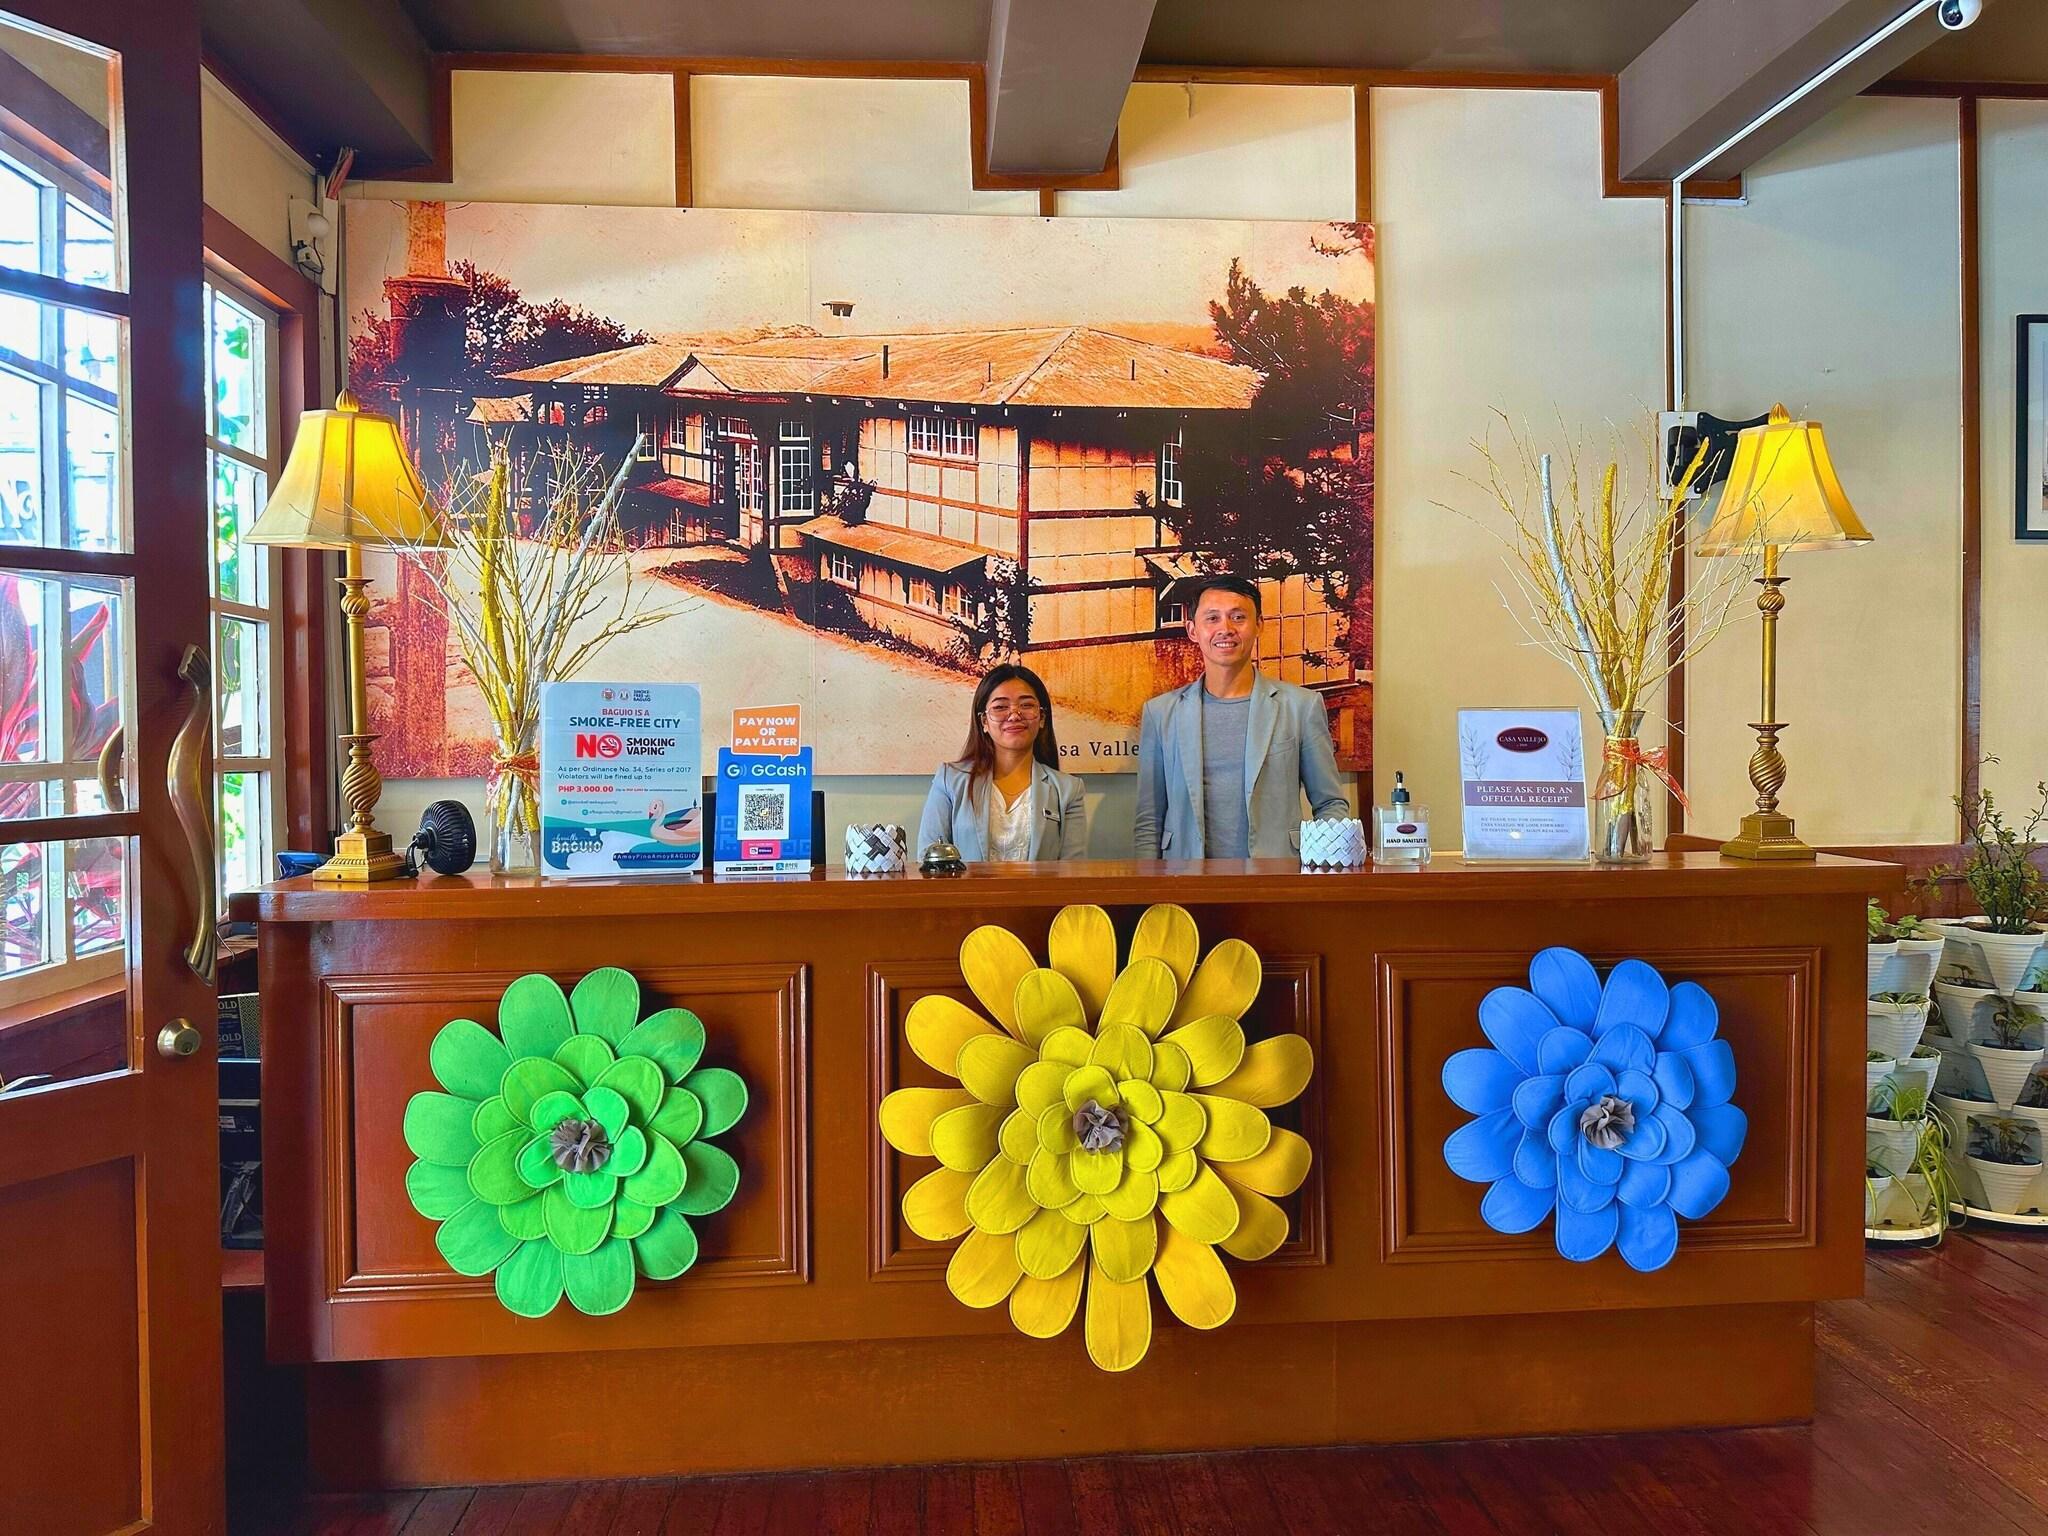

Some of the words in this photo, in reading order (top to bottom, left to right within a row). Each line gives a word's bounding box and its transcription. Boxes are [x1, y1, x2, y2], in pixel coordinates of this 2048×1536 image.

[602, 708, 633, 716] BAGUIO
[569, 717, 651, 728] SMOKE-FREE
[653, 718, 681, 728] CITY
[739, 717, 763, 726] PAY
[766, 717, 796, 726] NOW
[759, 727, 777, 736] OR
[626, 737, 675, 747] SMOKING
[735, 737, 760, 746] PAY
[761, 737, 798, 746] LATER
[1517, 736, 1546, 744] VALLEJO
[626, 747, 665, 756] VAPING
[1059, 744, 1080, 757] sa
[1089, 740, 1140, 757] Valle
[751, 763, 807, 777] GCash
[558, 785, 575, 793] PHP
[1476, 785, 1512, 793] PLEASE
[1514, 786, 1534, 794] ASK
[1536, 786, 1556, 794] FOR
[1558, 786, 1573, 794] AN
[1528, 795, 1569, 803] RECEIPT
[551, 840, 602, 853] BAGUIO
[218, 1000, 238, 1010] OLD
